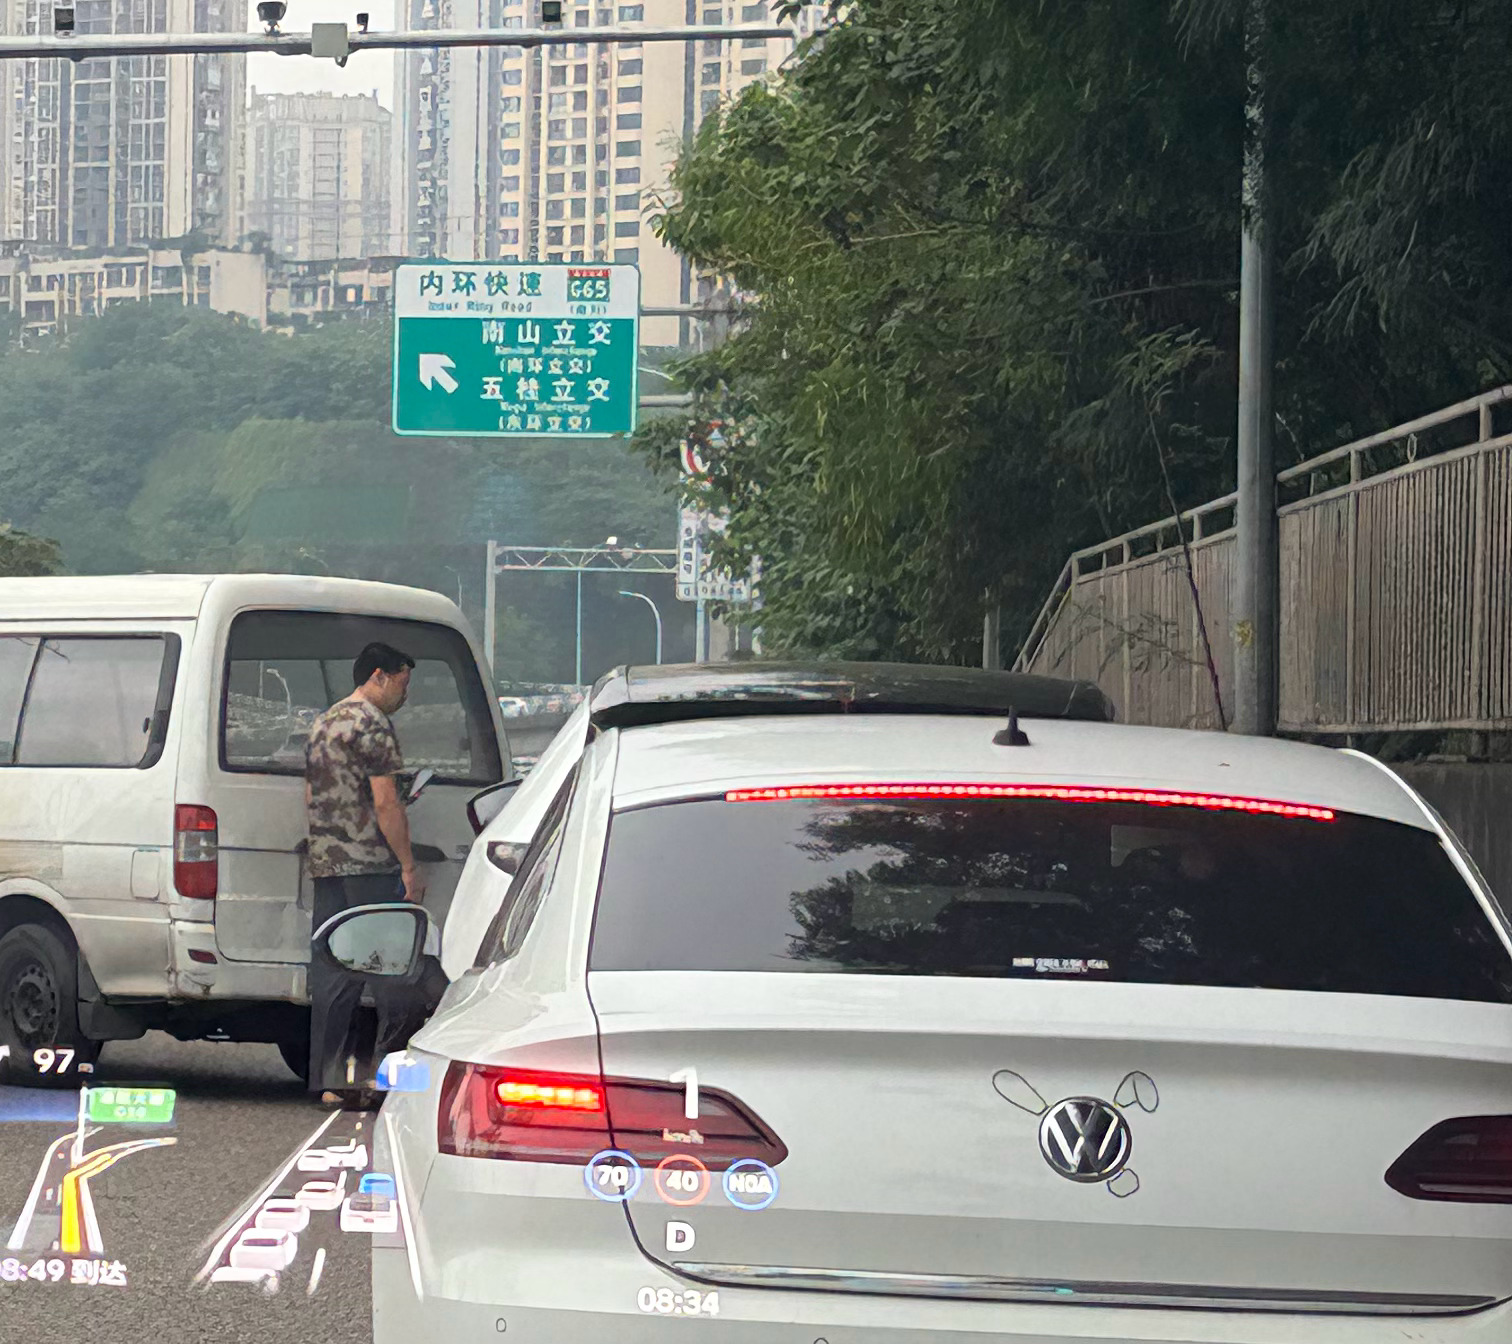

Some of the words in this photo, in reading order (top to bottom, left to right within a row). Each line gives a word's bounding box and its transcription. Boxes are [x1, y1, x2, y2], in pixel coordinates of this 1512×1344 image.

[419, 270, 542, 296] 内环快速
[570, 279, 608, 299] G65
[481, 319, 612, 346] 南山立交
[32, 1047, 76, 1074] 97
[669, 1065, 699, 1120] 1
[597, 1164, 629, 1187] 70
[665, 1170, 699, 1192] 40
[728, 1173, 773, 1194] NOA
[665, 1221, 696, 1252] D
[70, 1258, 128, 1286] 到达
[637, 1286, 720, 1316] 08:34
